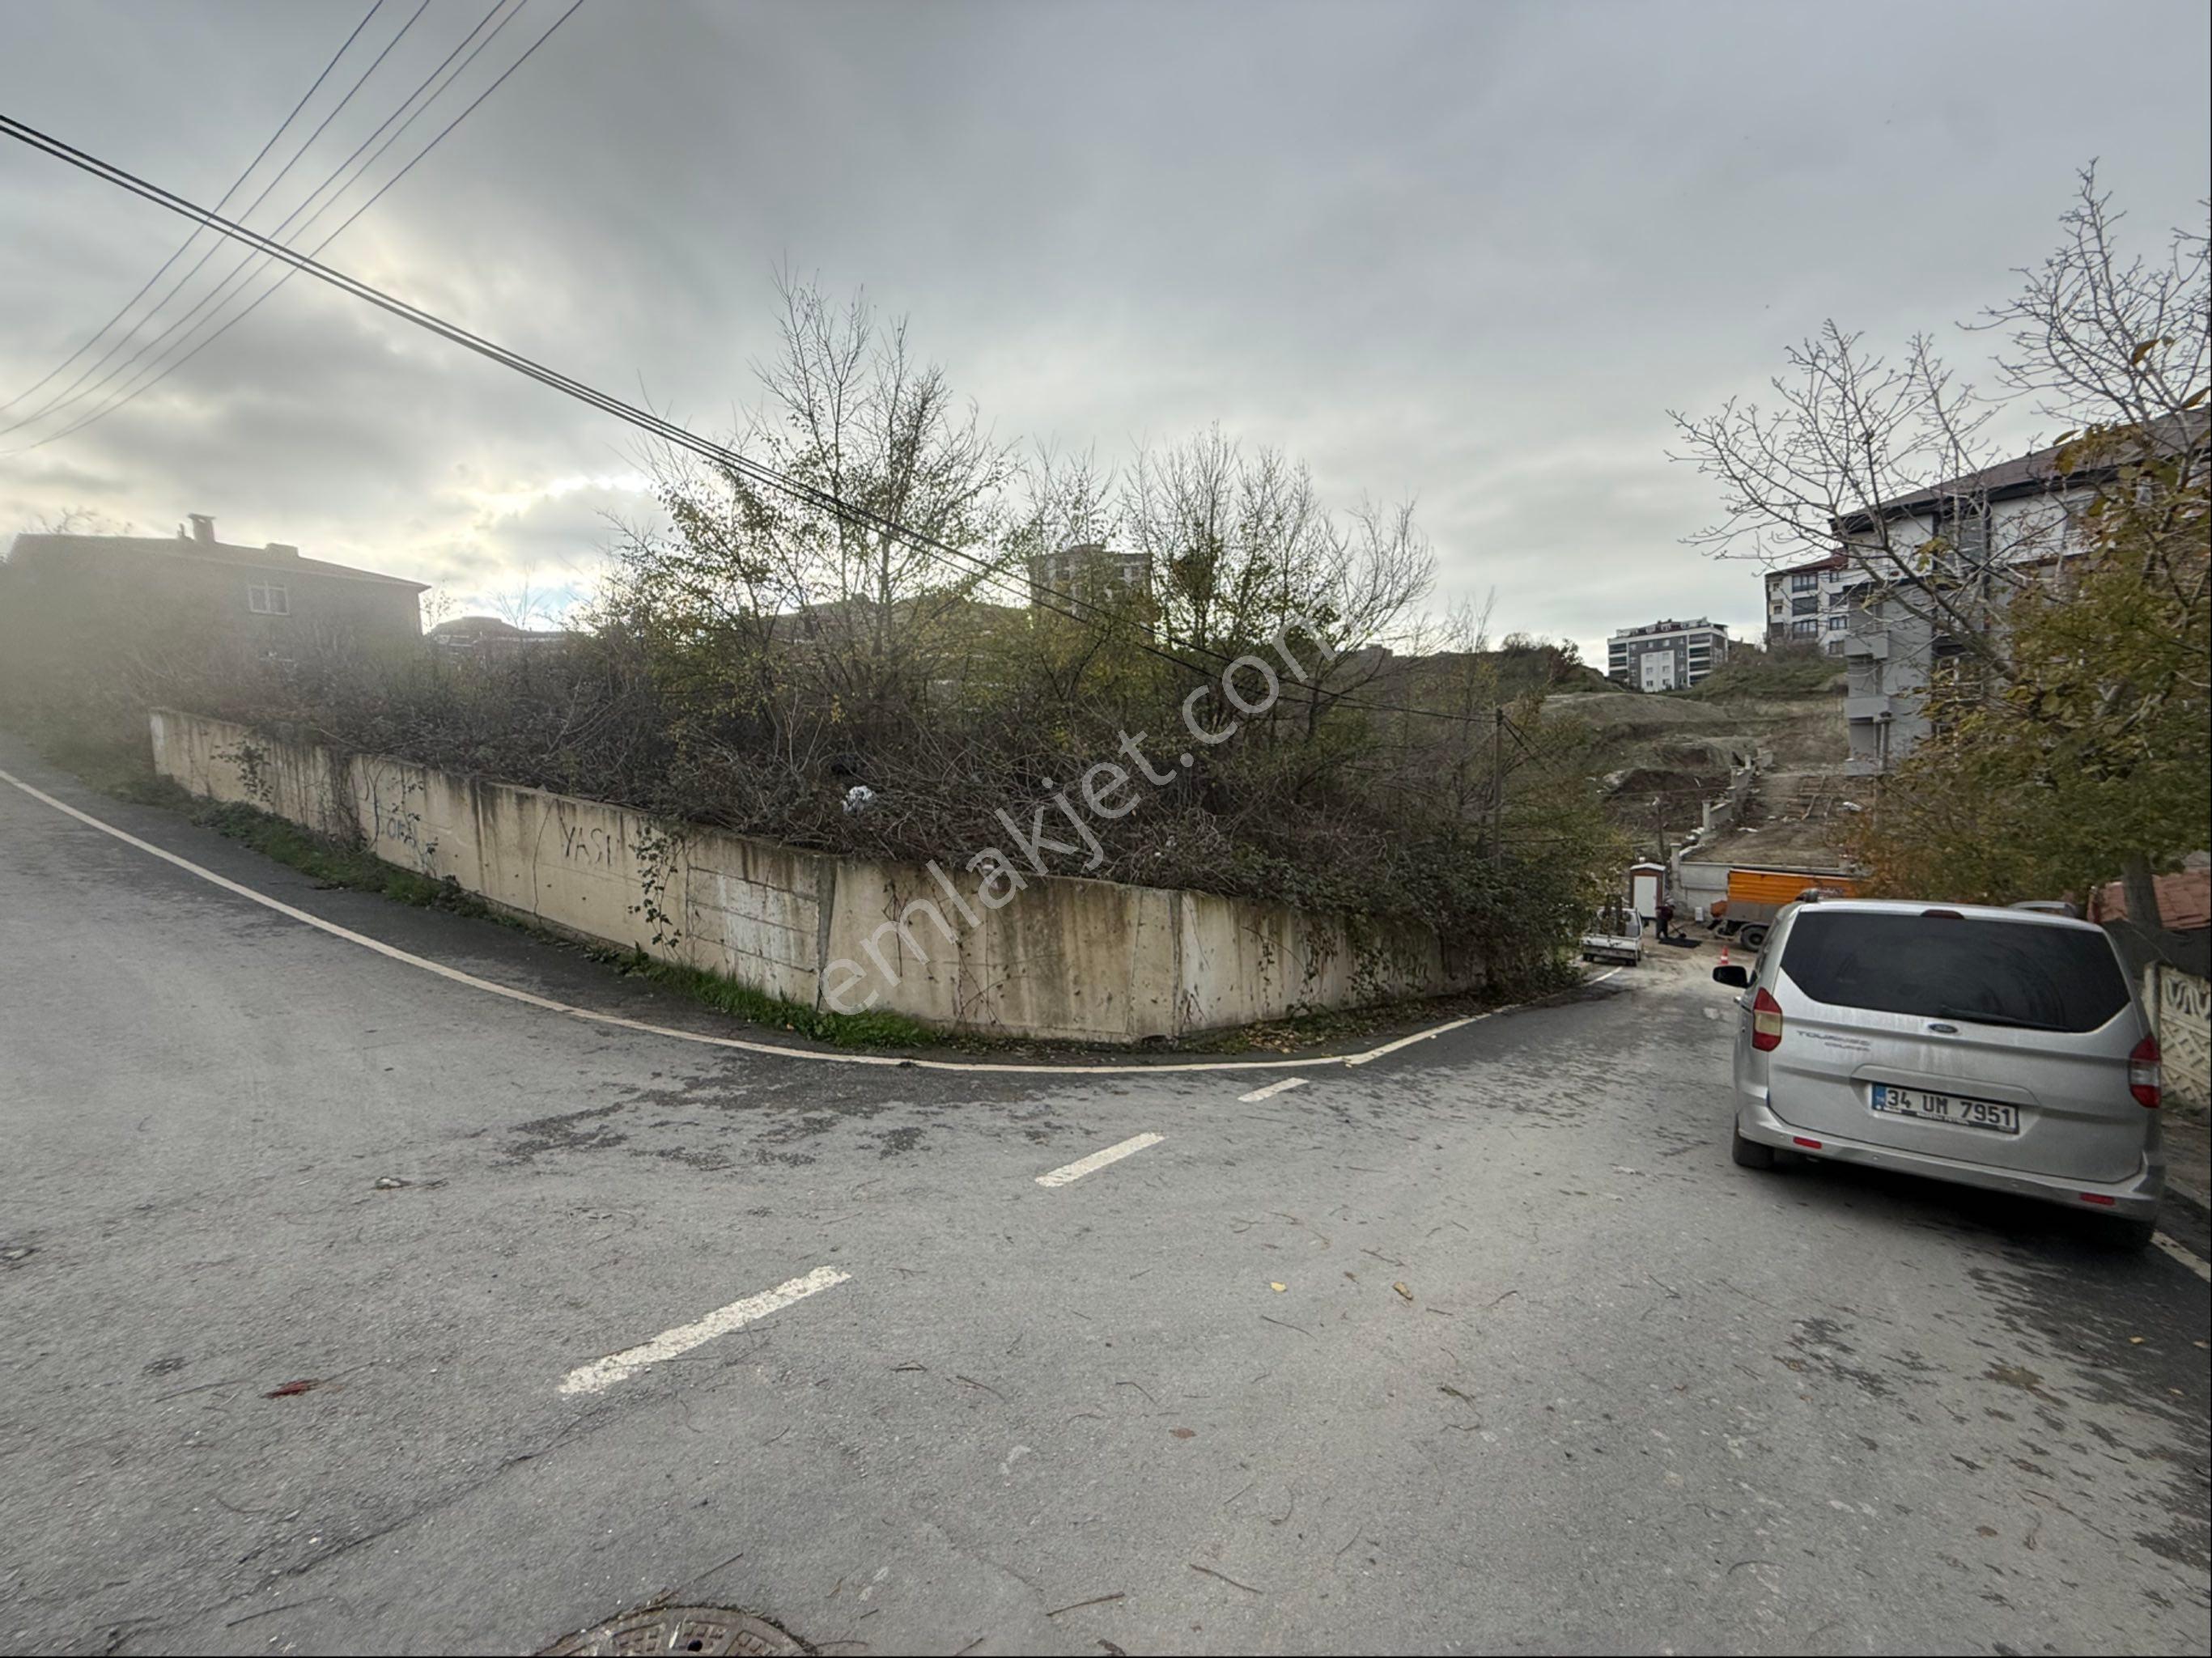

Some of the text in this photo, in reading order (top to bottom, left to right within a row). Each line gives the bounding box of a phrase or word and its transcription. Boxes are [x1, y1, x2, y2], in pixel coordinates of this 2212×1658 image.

[1887, 1089, 1912, 1109] 34
[1922, 1095, 1949, 1115] UM
[1960, 1100, 2010, 1126] 7951
